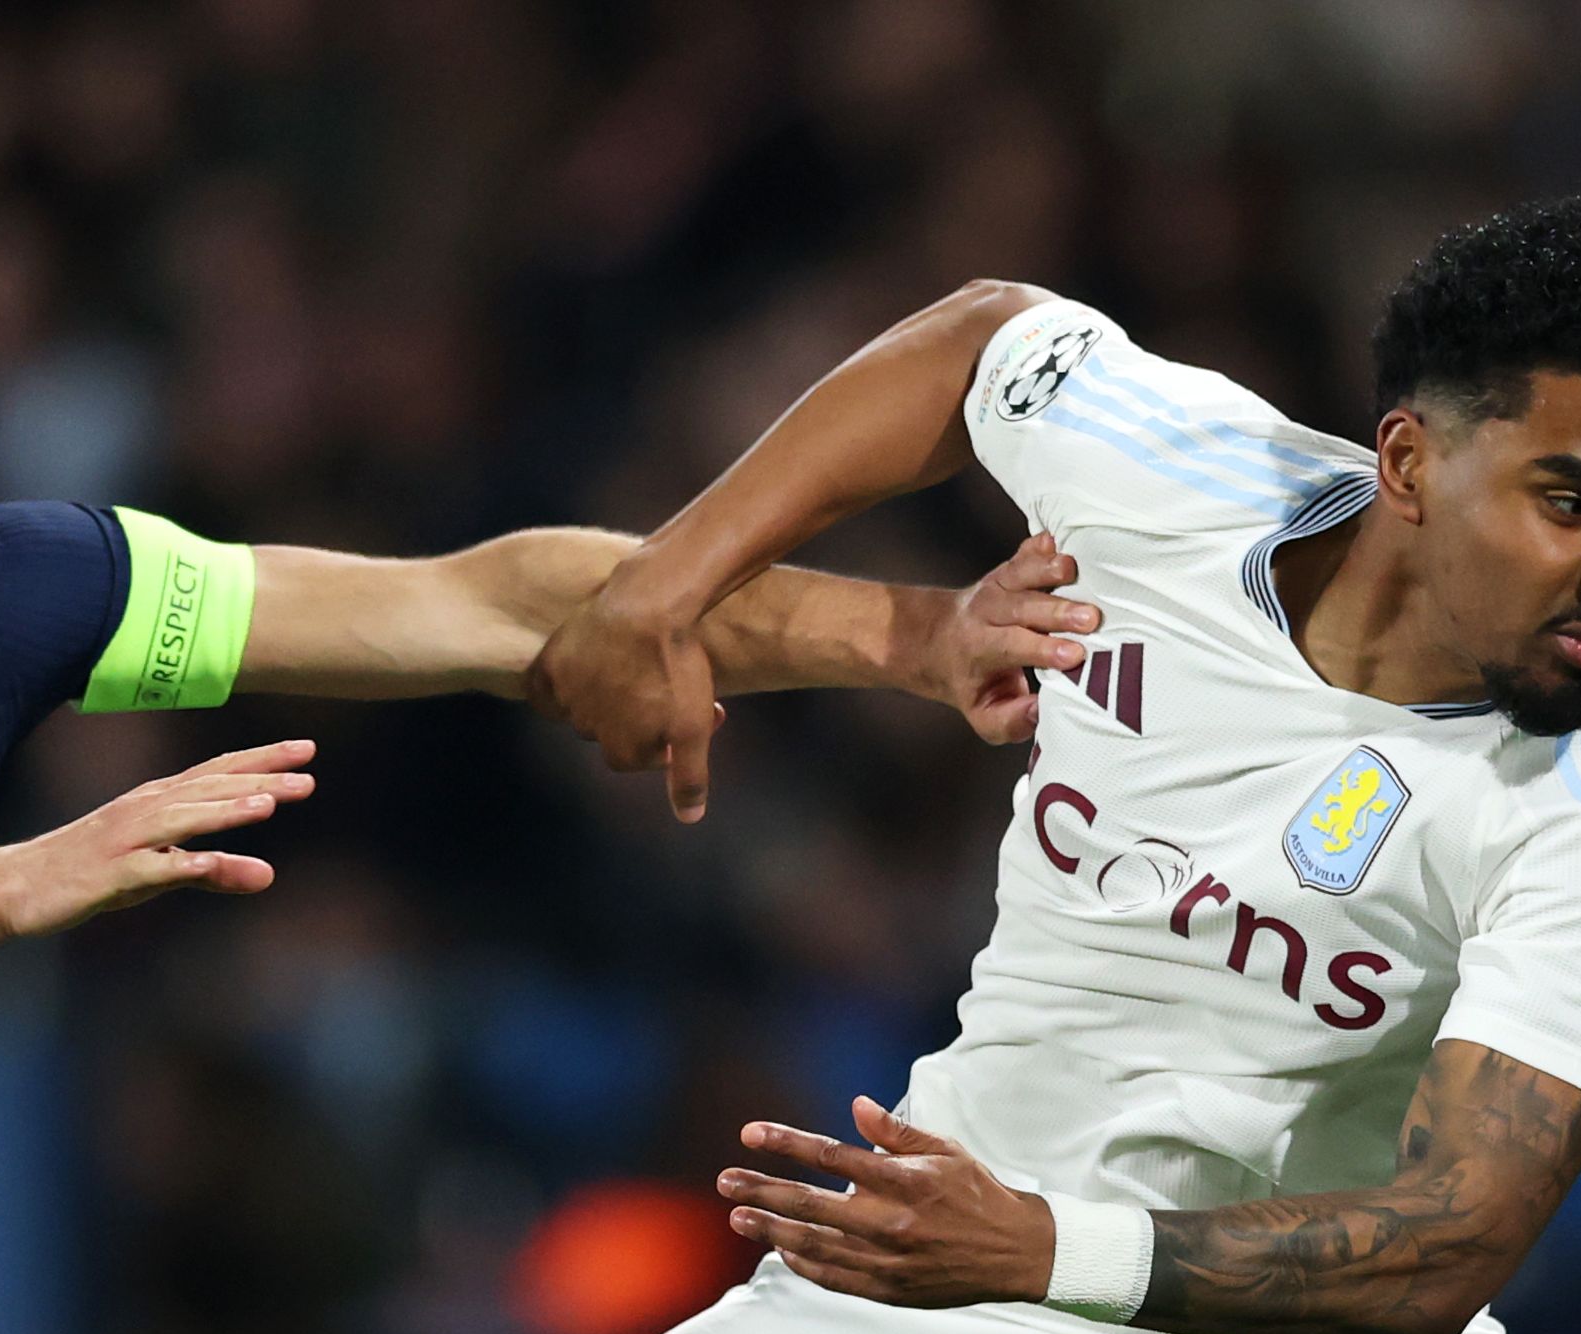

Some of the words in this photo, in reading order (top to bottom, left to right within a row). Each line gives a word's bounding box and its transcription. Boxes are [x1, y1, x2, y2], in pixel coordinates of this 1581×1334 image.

[151, 554, 199, 684] RESPECT
[1027, 743, 1393, 1031] corns
[1290, 833, 1315, 872] ASTON
[1314, 865, 1347, 884] VILLA
